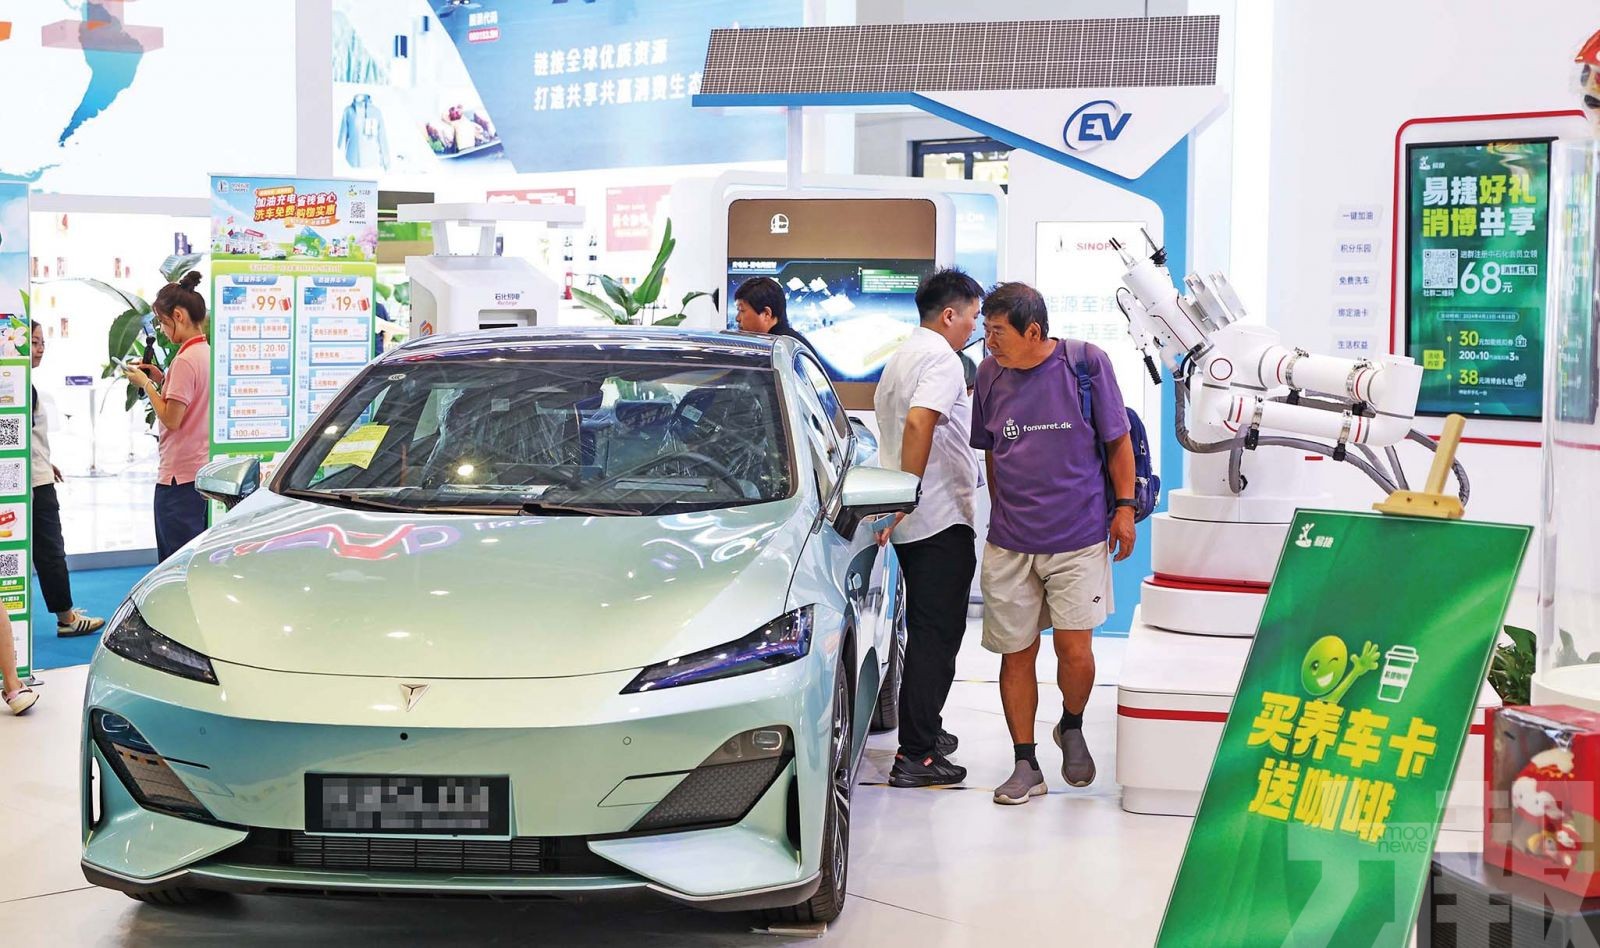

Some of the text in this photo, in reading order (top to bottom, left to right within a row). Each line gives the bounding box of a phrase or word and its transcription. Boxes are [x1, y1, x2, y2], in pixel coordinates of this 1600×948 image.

[533, 39, 668, 76] 链接全球优质资源
[1078, 113, 1132, 141] EV
[1423, 174, 1537, 206] 易捷好礼
[256, 194, 296, 209] 加油充电
[255, 204, 296, 221] 洗车免费
[1343, 211, 1374, 220] 一键加油
[1423, 207, 1536, 238] 消博共享
[1341, 244, 1371, 253] 积分乐园
[1339, 276, 1369, 285] 免费洗车
[1338, 340, 1368, 350] 生活权益
[1022, 421, 1072, 432] forsvaret.dk
[1313, 535, 1335, 549] 易捷
[1247, 691, 1439, 778] 买养车卡
[1247, 757, 1397, 844] 送咖啡
